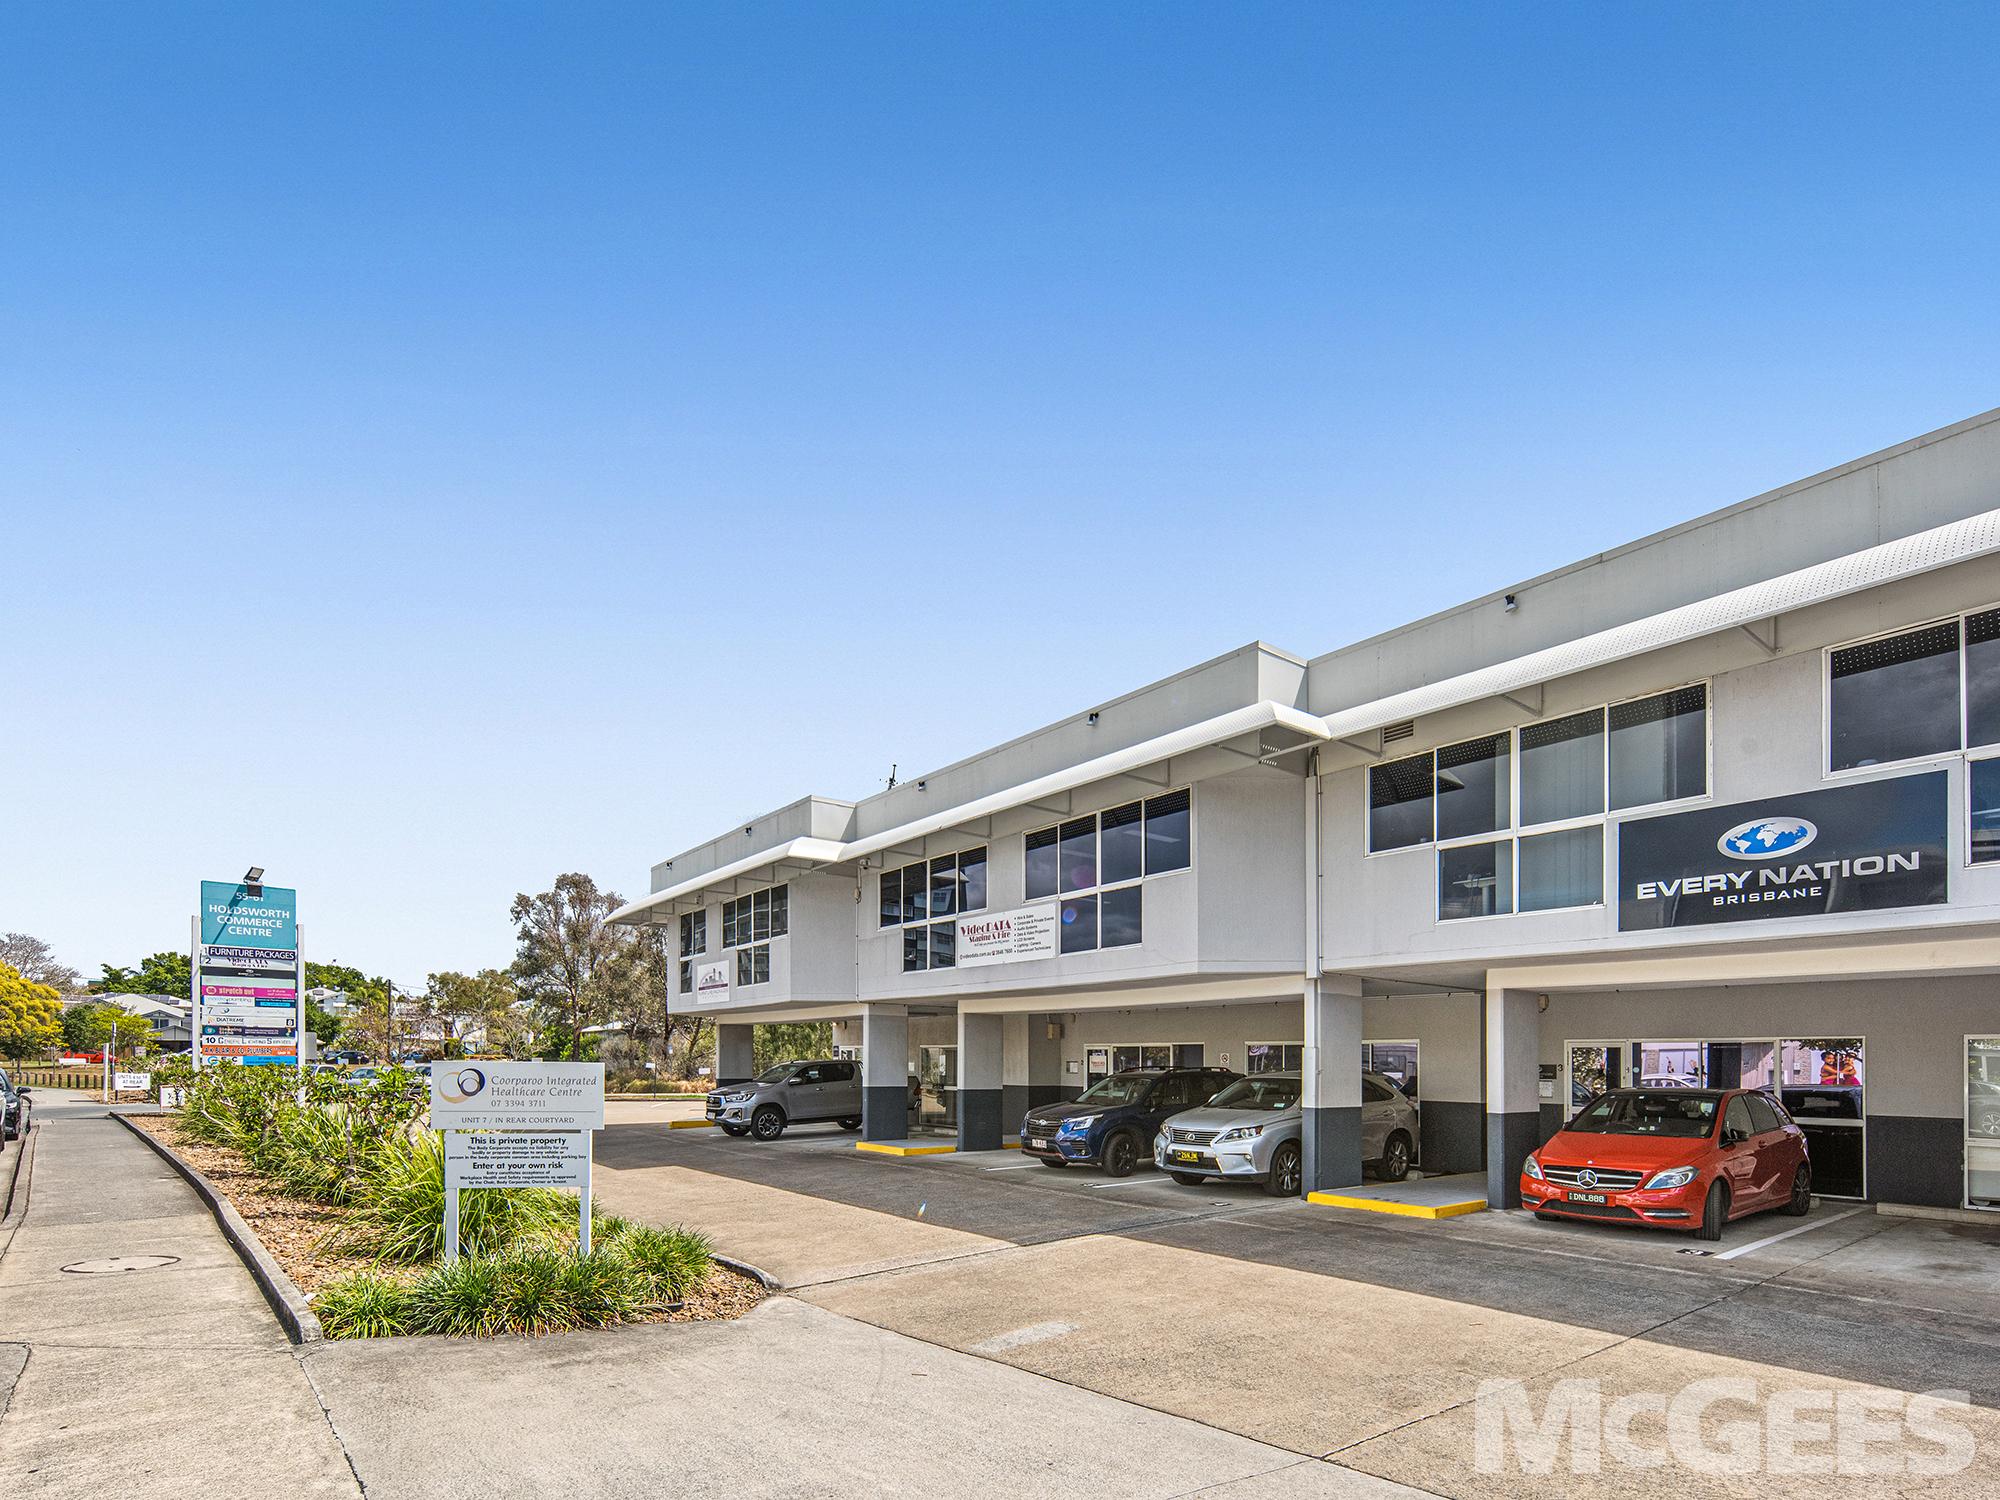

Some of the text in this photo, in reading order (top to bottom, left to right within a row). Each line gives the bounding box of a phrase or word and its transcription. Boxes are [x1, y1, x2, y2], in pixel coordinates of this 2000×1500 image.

[1636, 851, 1920, 900] EVERY NATION
[1713, 886, 1822, 906] BRISBANE
[209, 904, 290, 918] HOLDSWORTH
[217, 916, 282, 928] COMMERCE
[960, 919, 1012, 936] VideoDATA
[228, 926, 272, 936] CENTRE
[210, 948, 294, 960] FURNITURE PACKAGES
[1558, 1064, 1563, 1072] 3
[491, 1075, 597, 1087] Coorparoo Integrated
[491, 1086, 582, 1096] Healthcare Centre
[499, 1137, 527, 1146] private
[531, 1138, 566, 1147] property
[1573, 1193, 1604, 1203] DNL888
